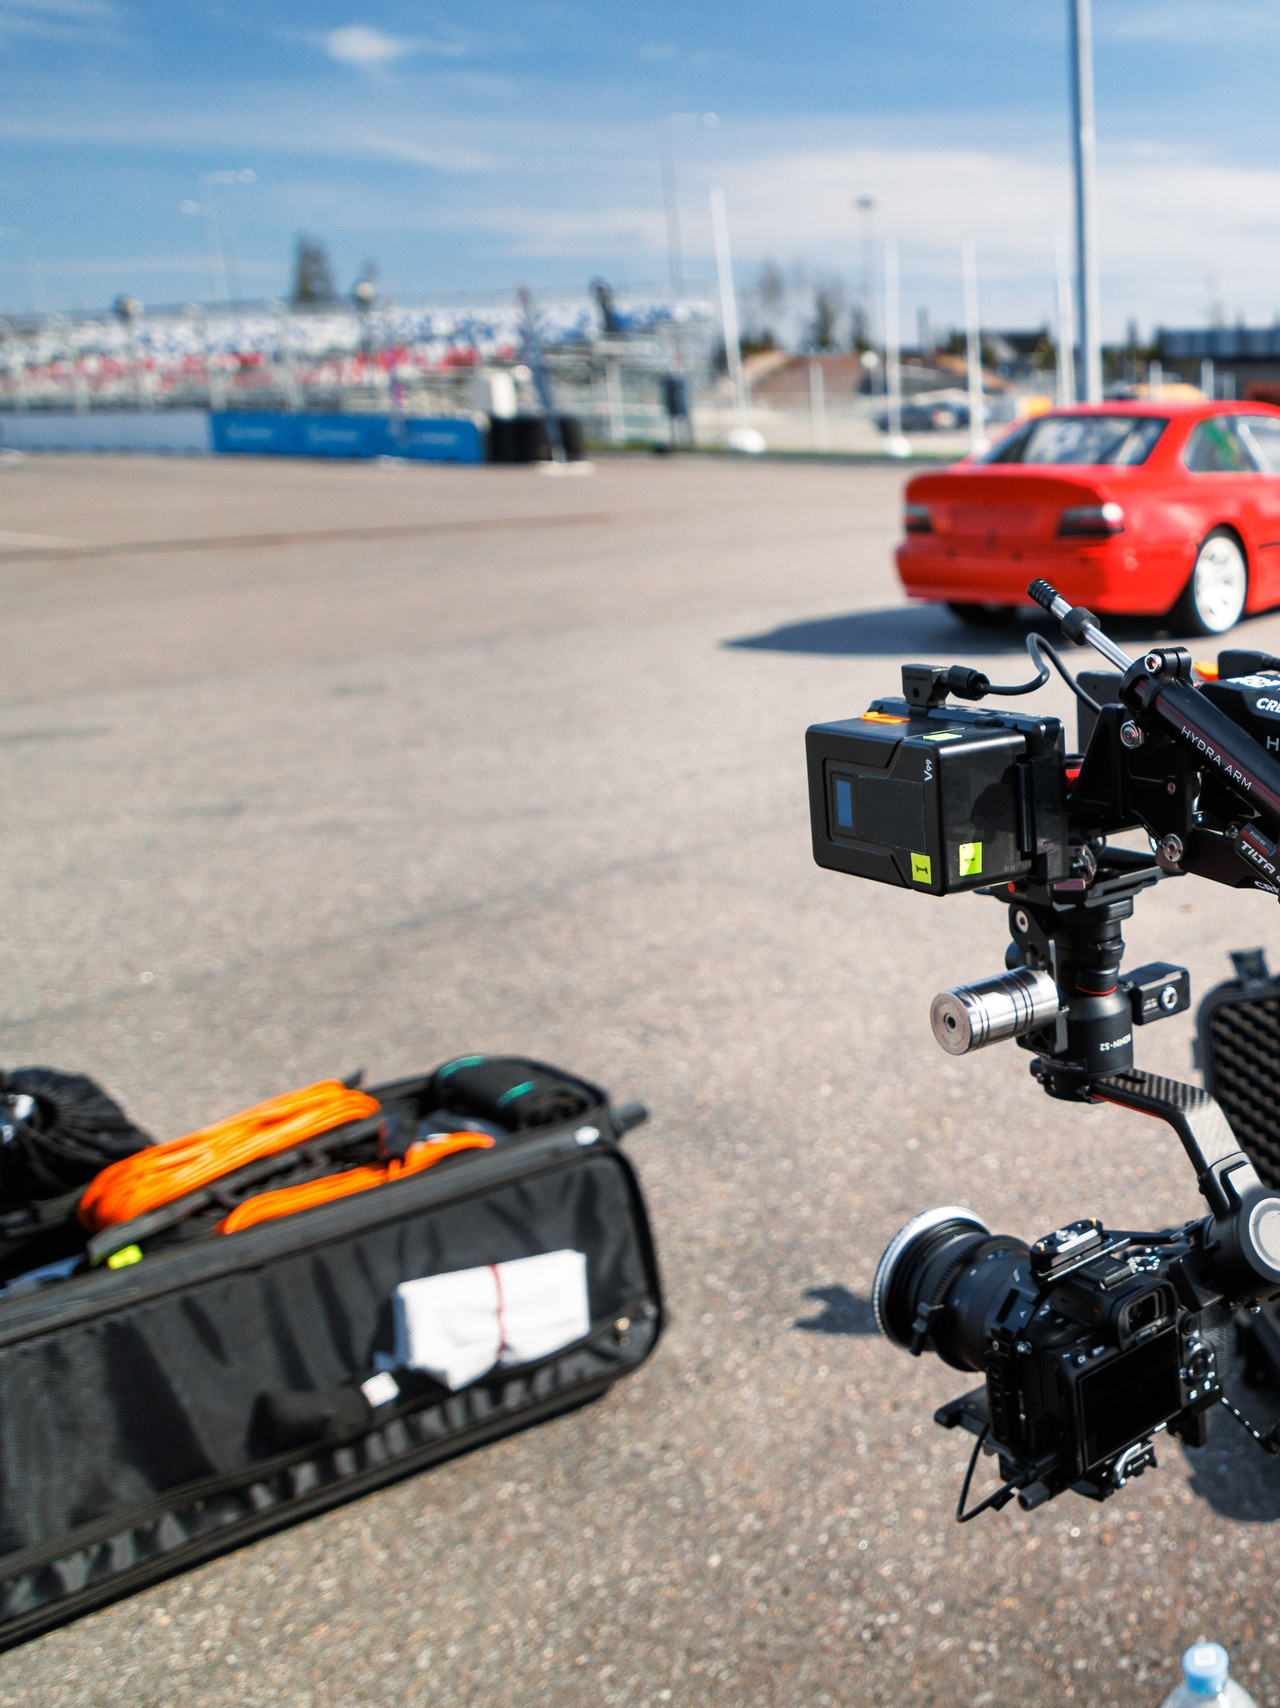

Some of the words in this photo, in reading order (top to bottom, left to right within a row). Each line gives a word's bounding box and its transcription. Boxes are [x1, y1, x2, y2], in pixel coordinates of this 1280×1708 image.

[924, 759, 933, 781] V99
[1181, 726, 1221, 766] HYDRA
[1224, 765, 1252, 790] ARM
[1241, 840, 1276, 875] TILTA
